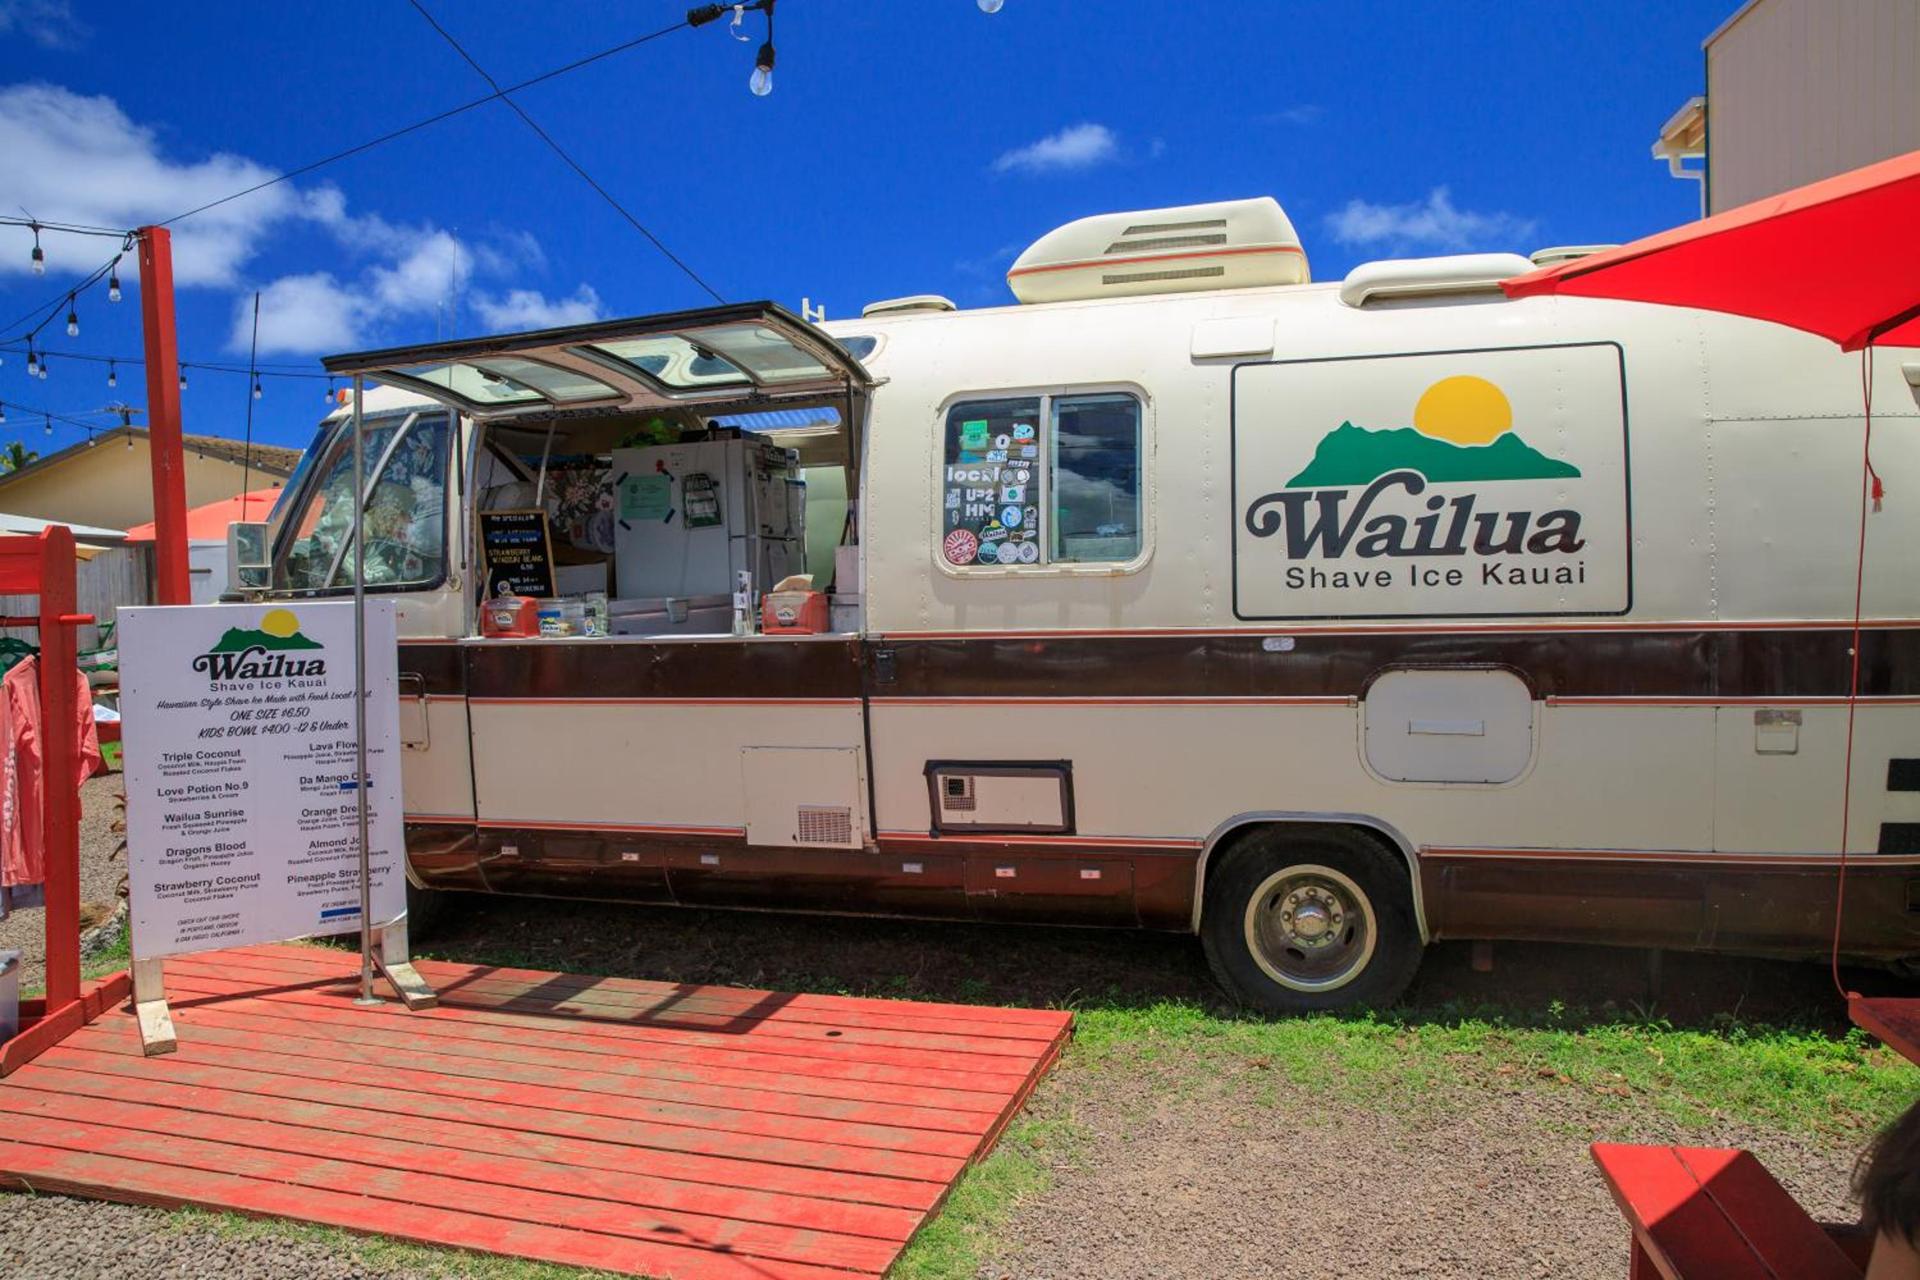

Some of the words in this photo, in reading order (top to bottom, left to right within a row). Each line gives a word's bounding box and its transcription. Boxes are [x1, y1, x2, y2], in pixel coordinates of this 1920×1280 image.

[1245, 471, 1586, 560] Wailua
[1285, 566, 1393, 589] Shave
[1410, 565, 1463, 587] Ice
[1482, 561, 1586, 586] Kauai
[192, 646, 327, 681] Wailua
[210, 681, 254, 692] Shave
[260, 681, 282, 690] Ice
[287, 678, 327, 688] Kauai
[200, 697, 222, 711] Style
[230, 709, 254, 721] ONE
[255, 707, 281, 720] SIZE
[198, 726, 225, 739] KIDS
[227, 725, 258, 737] BOWL
[319, 719, 350, 731] Under
[309, 742, 333, 752] Lava
[162, 752, 193, 763] Triple
[196, 748, 241, 760] Coconut
[299, 776, 313, 785] Da
[316, 774, 349, 783] Mango
[157, 787, 184, 797] Love
[187, 784, 222, 795] Potion
[225, 781, 249, 792] No.9
[164, 812, 201, 823] Wailua
[204, 809, 245, 820] Sunrise
[301, 808, 338, 818] Orange
[166, 846, 212, 857] Dragons
[215, 840, 246, 852] Blood
[309, 837, 347, 849] Almond
[154, 879, 213, 893] Strawberry
[216, 872, 261, 885] Coconut
[287, 871, 336, 884] Pineapple
